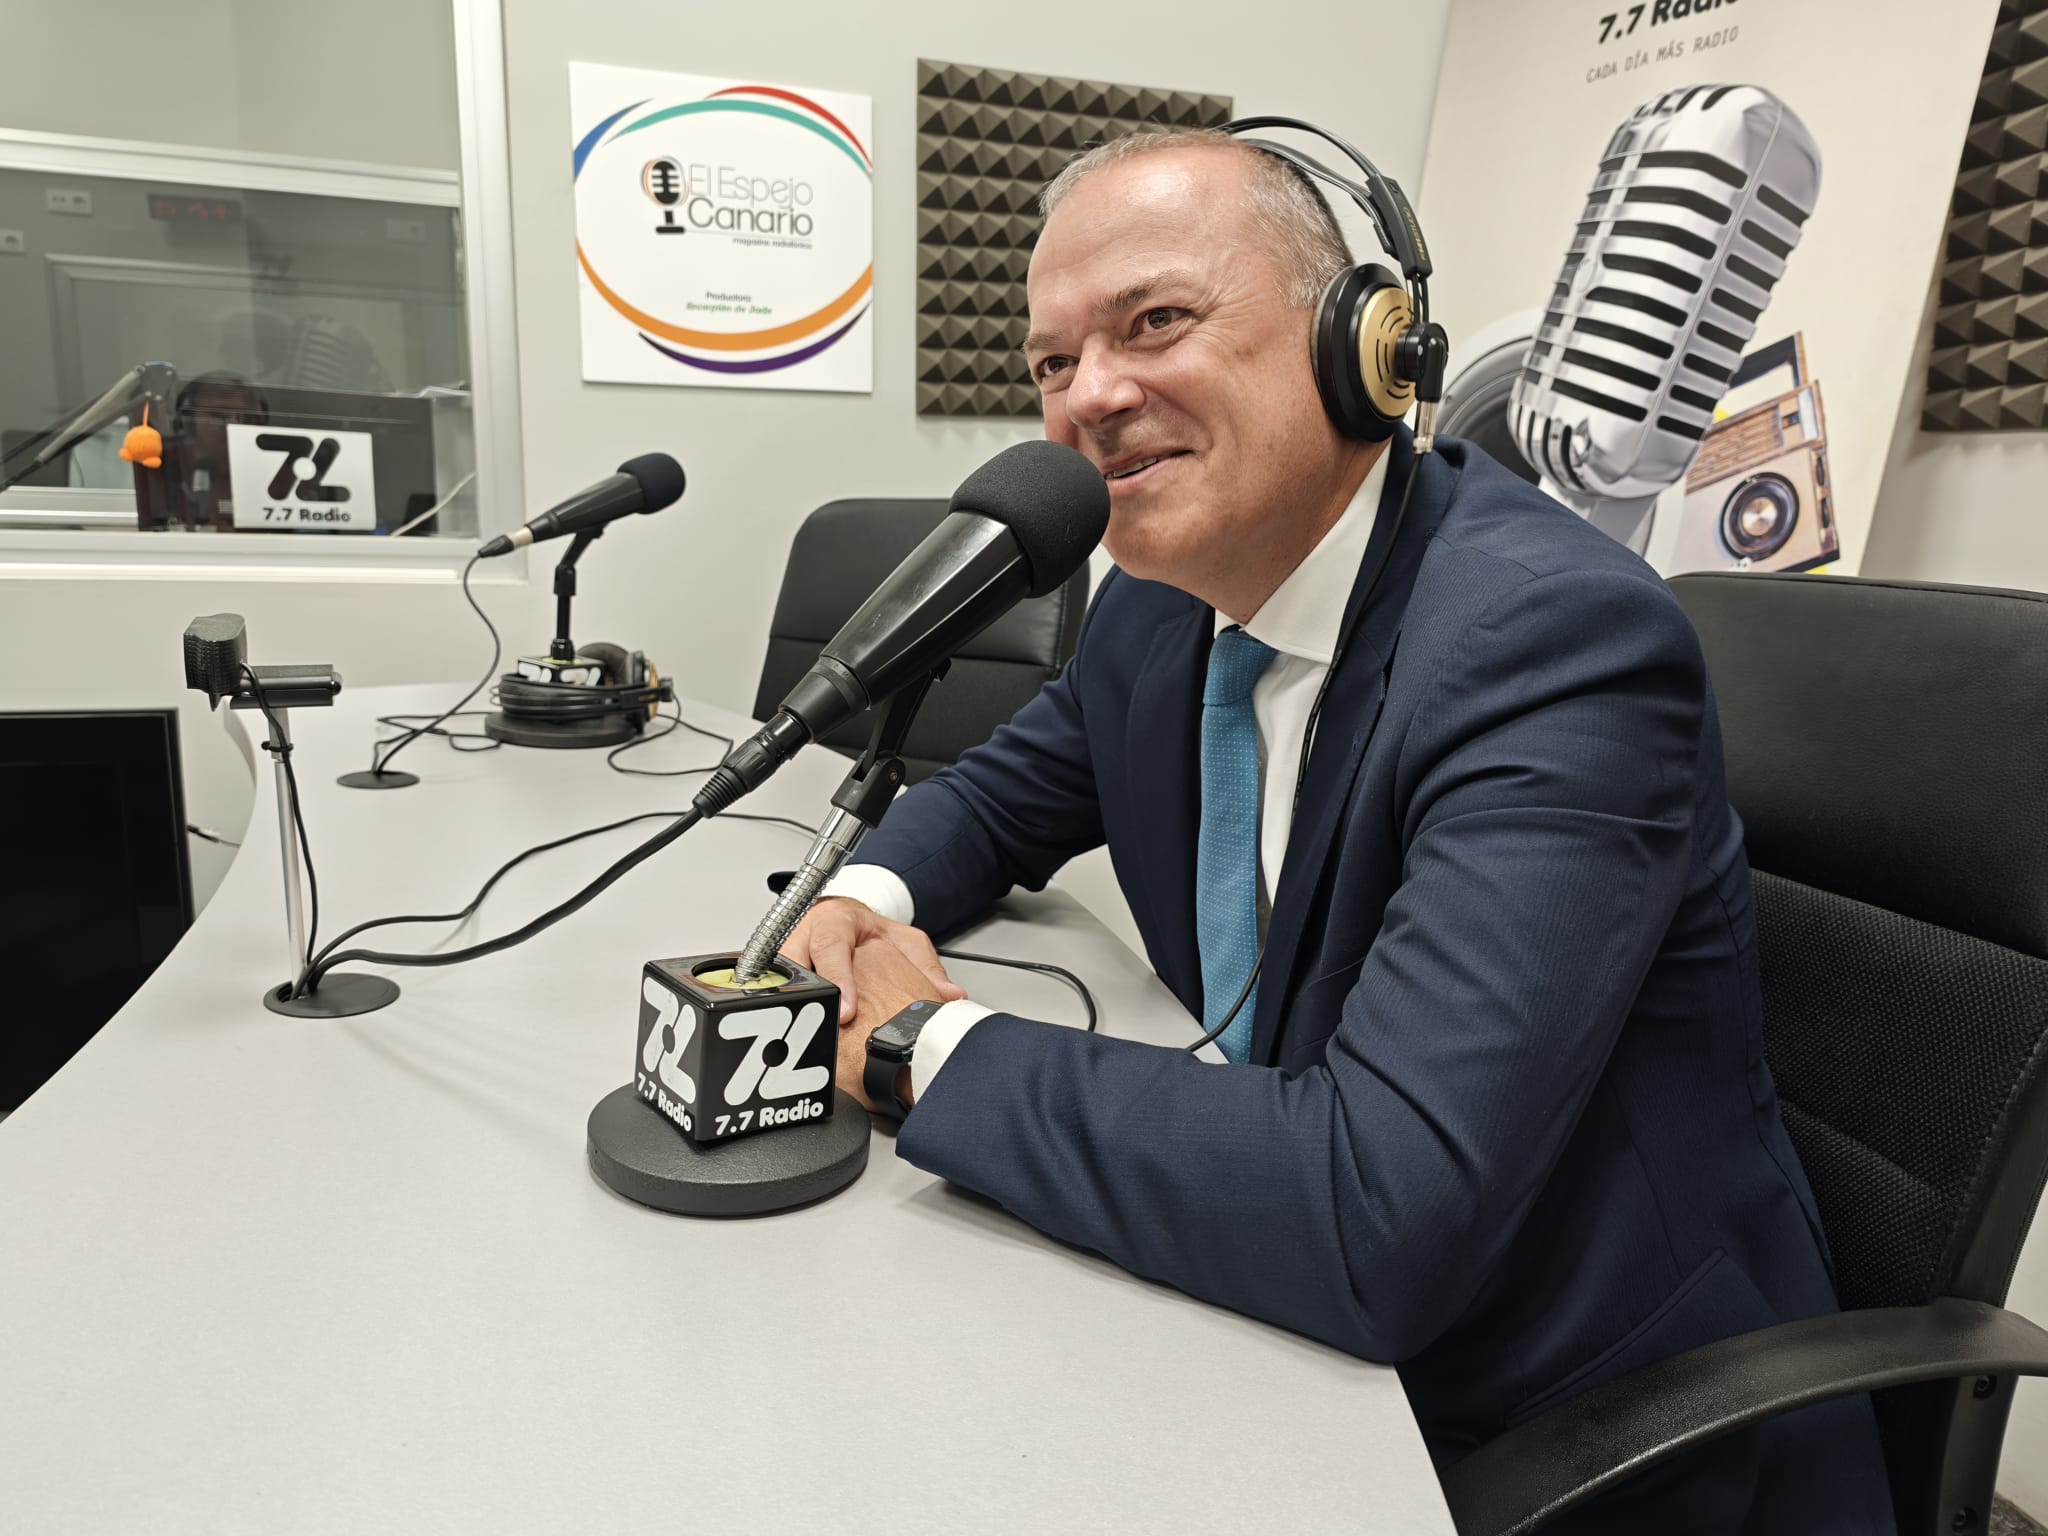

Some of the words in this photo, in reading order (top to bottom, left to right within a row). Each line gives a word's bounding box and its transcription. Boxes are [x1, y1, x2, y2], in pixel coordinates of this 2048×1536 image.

[1598, 4, 1646, 44] 7.7
[1586, 61, 1618, 83] CADA
[1624, 49, 1649, 72] DÍA
[1656, 40, 1685, 62] MÁS
[1693, 25, 1740, 53] RADIO
[717, 165, 814, 209] Espejo
[688, 196, 814, 236] Canario
[263, 507, 293, 521] 7.7
[300, 507, 351, 522] Radio
[637, 1071, 657, 1101] 7.7
[658, 1088, 692, 1132] Radio
[714, 1110, 754, 1136] 7.7
[759, 1097, 824, 1128] Radio
